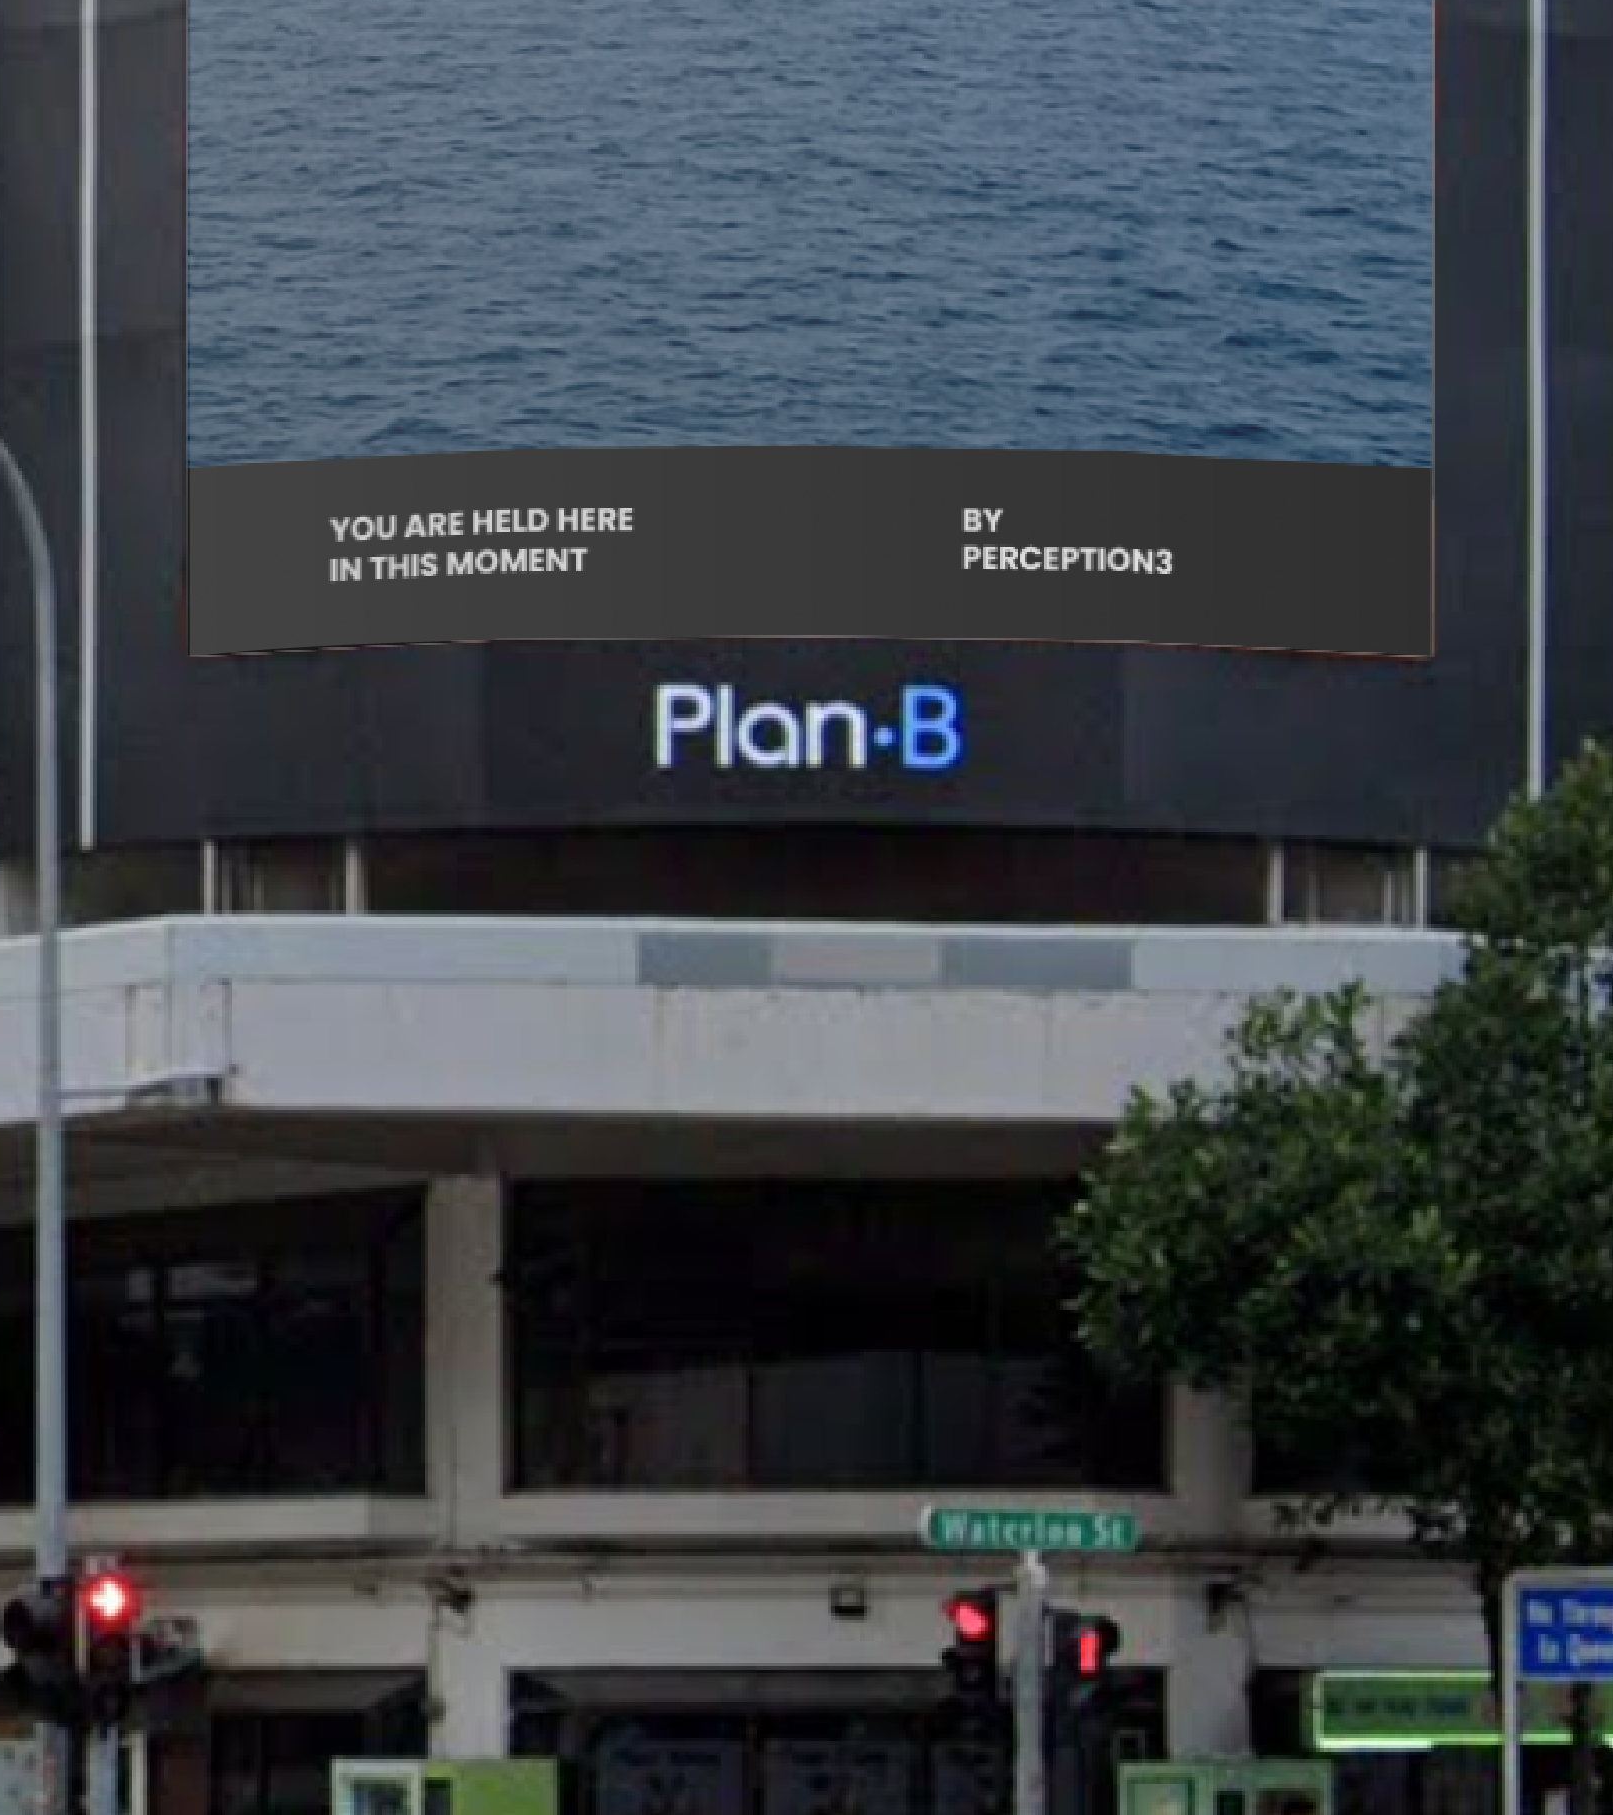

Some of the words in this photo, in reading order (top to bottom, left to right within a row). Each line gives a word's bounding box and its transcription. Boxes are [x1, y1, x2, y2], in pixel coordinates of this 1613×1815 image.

[329, 514, 398, 543] YOU
[403, 511, 465, 538] ARE
[472, 507, 550, 536] HELD
[555, 506, 635, 534] HERE
[963, 507, 1004, 533] BY
[329, 555, 363, 582] IN
[368, 551, 439, 580] THIS
[445, 546, 589, 577] MOMENT
[963, 545, 1173, 576] PERCEPTION3
[942, 1512, 1082, 1547] Waterloo
[1093, 1512, 1125, 1547] St
